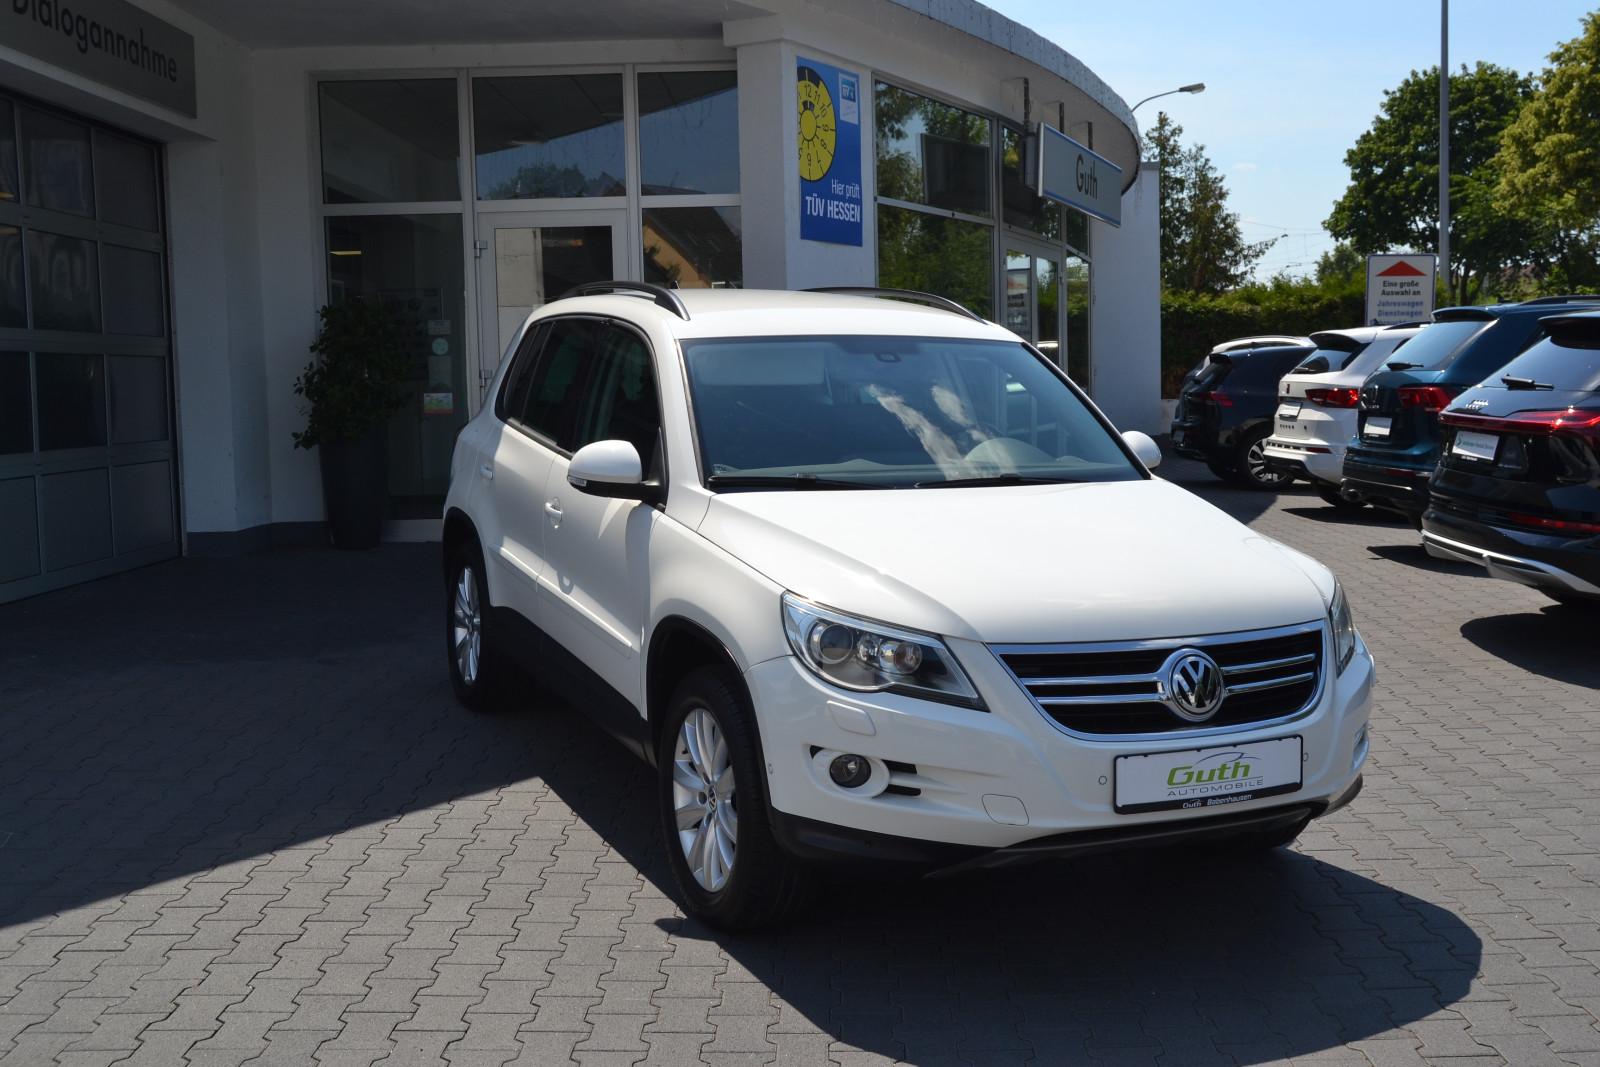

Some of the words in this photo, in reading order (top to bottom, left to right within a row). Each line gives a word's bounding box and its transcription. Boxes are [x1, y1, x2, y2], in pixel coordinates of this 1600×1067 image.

[1075, 153, 1098, 200] Guth
[831, 178, 844, 195] Hier
[845, 182, 860, 199] prüft
[805, 192, 825, 217] TÜV
[827, 199, 861, 223] HESSEN
[1399, 280, 1419, 289] große
[1167, 761, 1251, 786] Guth
[1167, 779, 1264, 797] AUTOMOBILE
[1182, 801, 1202, 809] Guth
